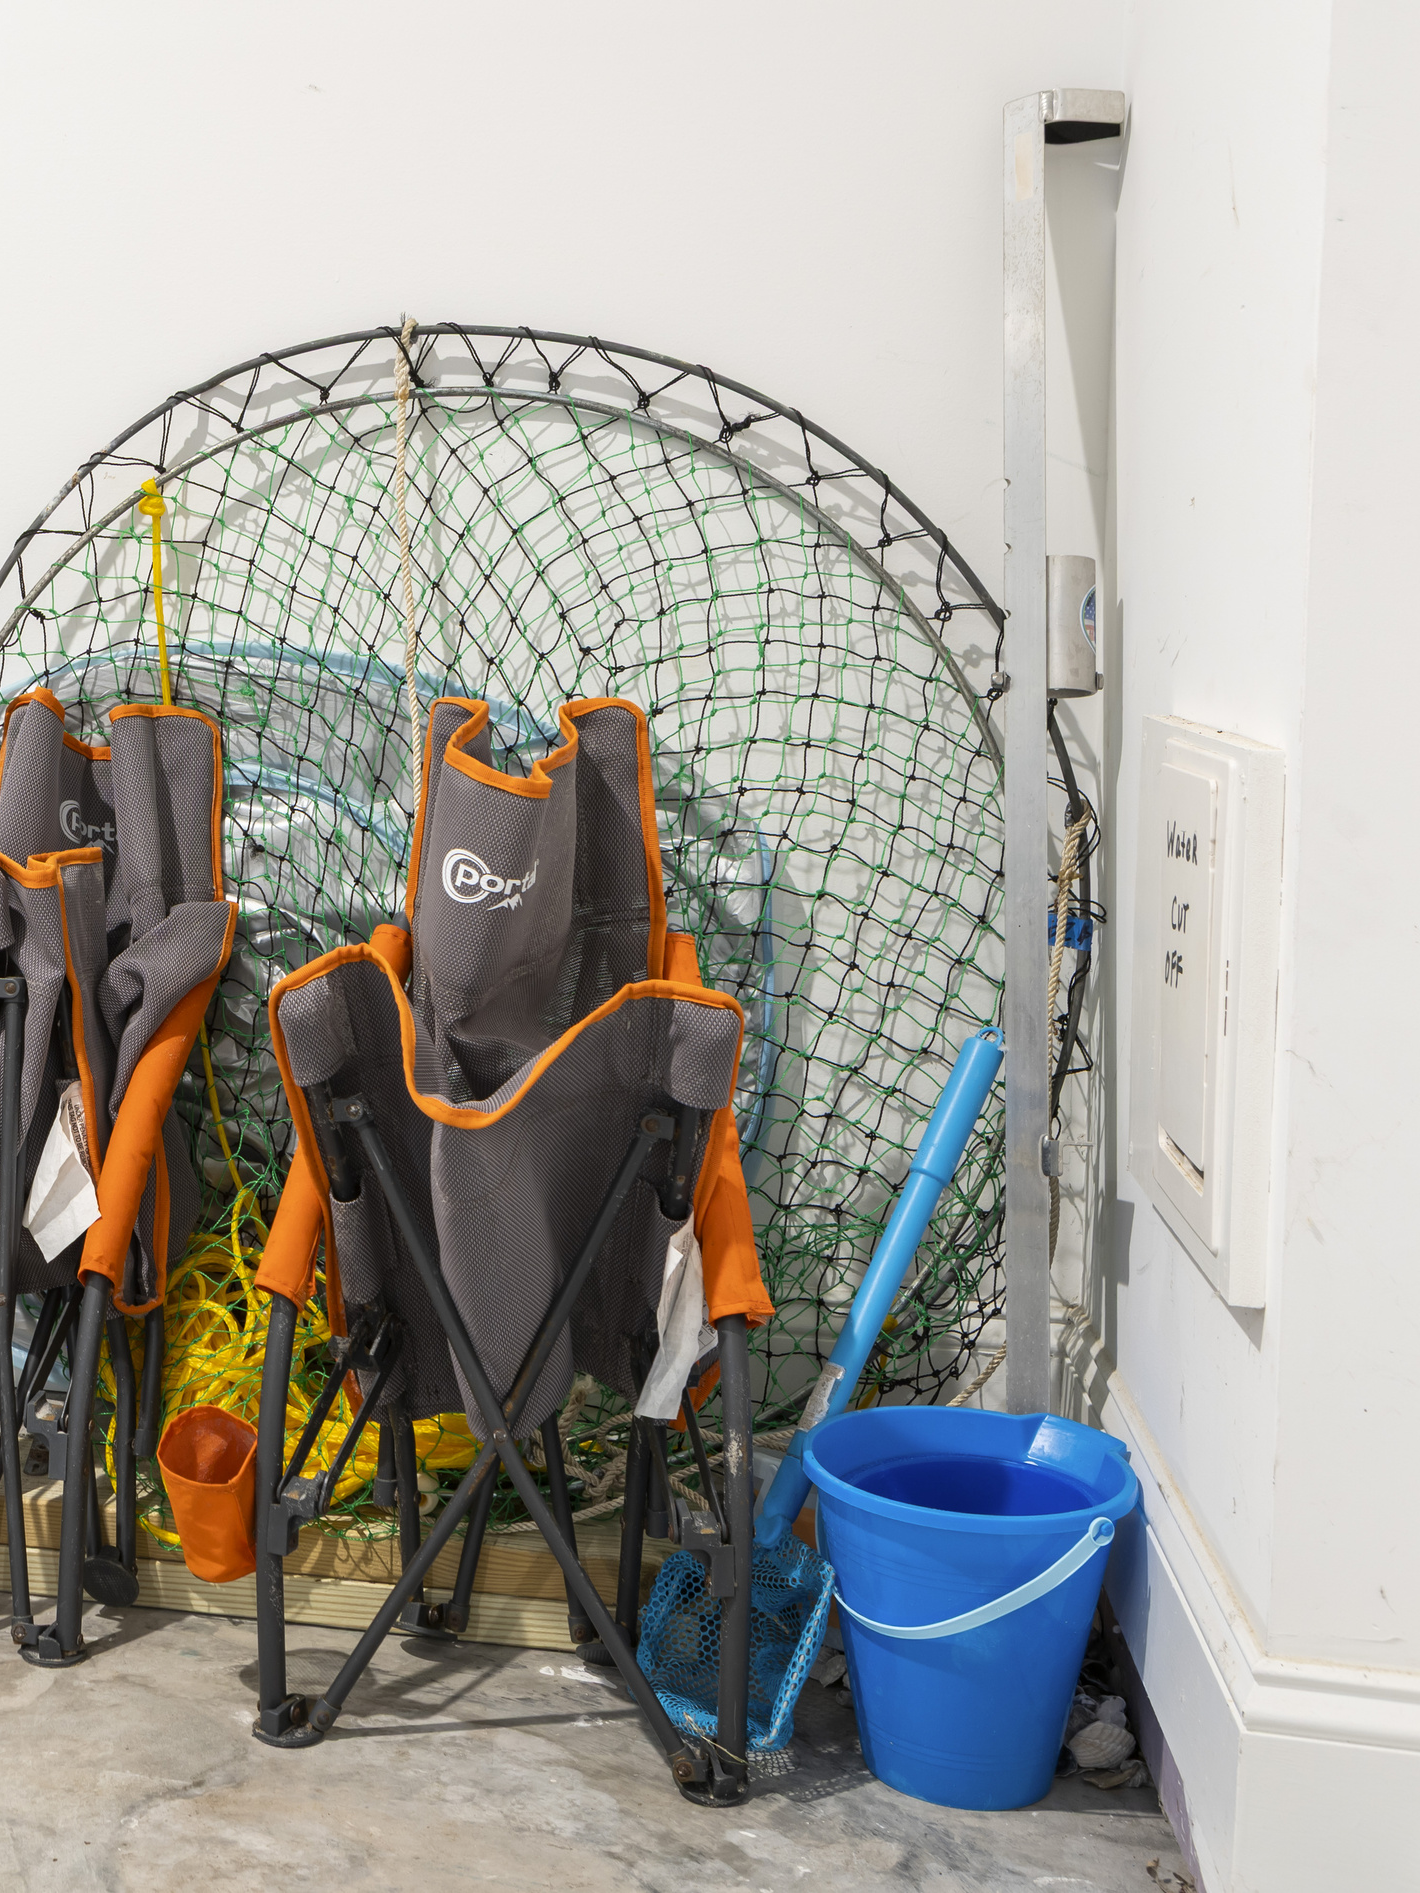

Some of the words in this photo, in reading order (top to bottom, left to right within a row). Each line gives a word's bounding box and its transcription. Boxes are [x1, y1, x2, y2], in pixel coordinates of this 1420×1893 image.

[1164, 950, 1183, 989] OFF
[71, 1121, 80, 1134] NOT
[74, 1133, 82, 1143] TO
[77, 1142, 84, 1152] BE
